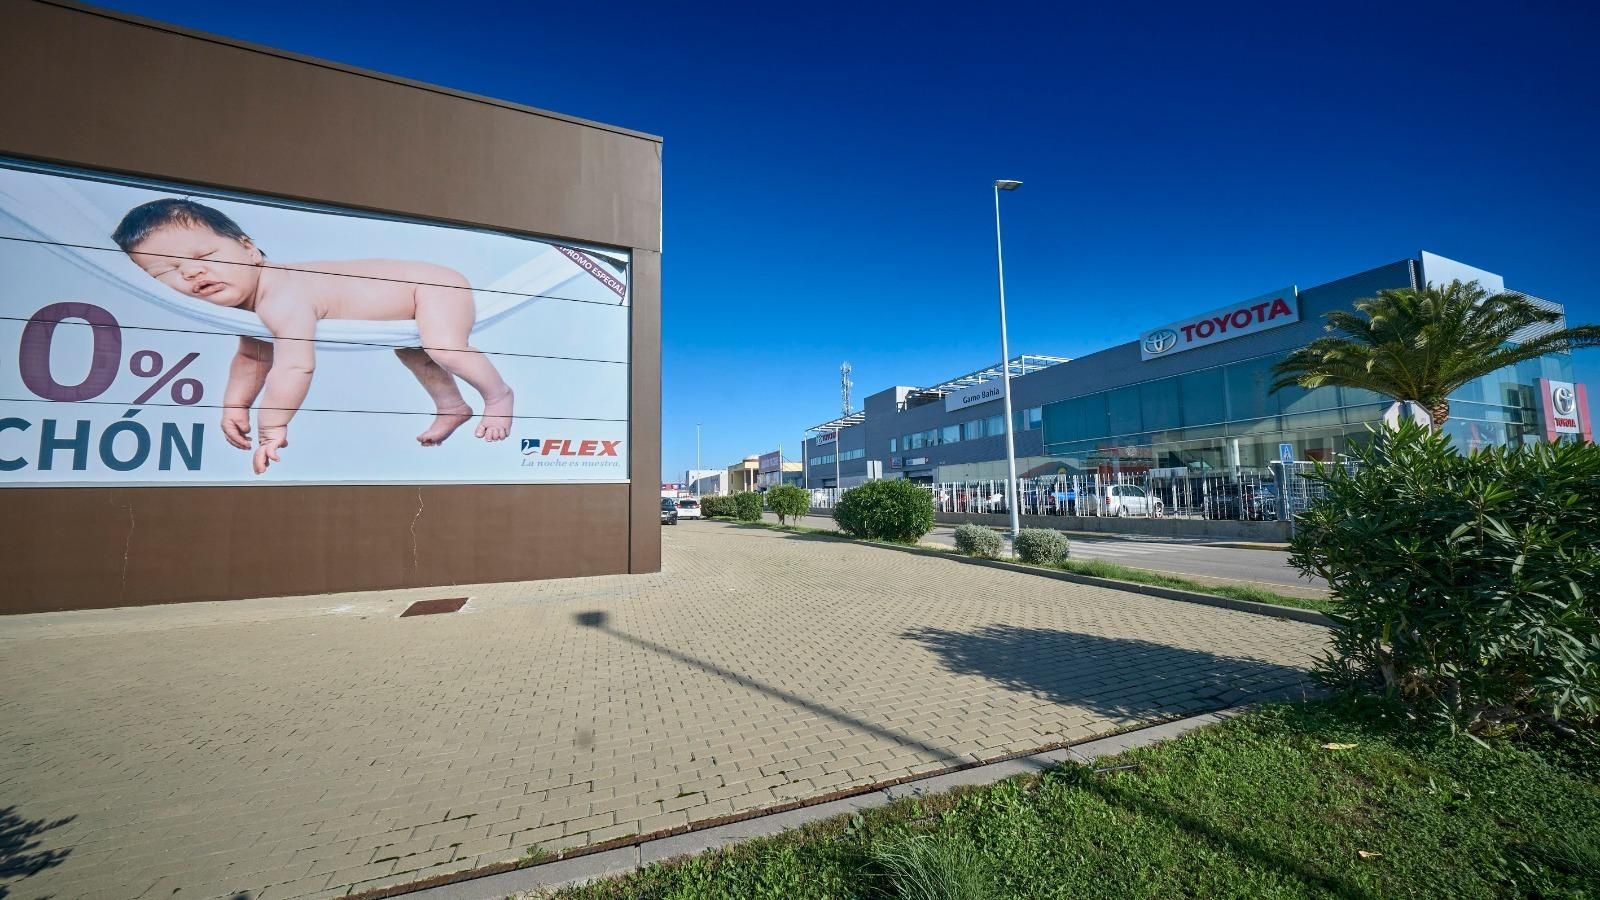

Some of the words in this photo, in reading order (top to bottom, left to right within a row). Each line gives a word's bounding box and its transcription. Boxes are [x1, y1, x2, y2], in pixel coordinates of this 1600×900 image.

[559, 246, 593, 270] PROMO
[1181, 298, 1293, 342] TOYOTA
[0, 301, 204, 406] 0%
[962, 394, 980, 403] Gamo
[1554, 417, 1577, 428] TOYOTA
[0, 408, 205, 471] CHÓN
[541, 440, 622, 456] FLEX
[520, 459, 534, 467] La
[537, 459, 567, 467] noche
